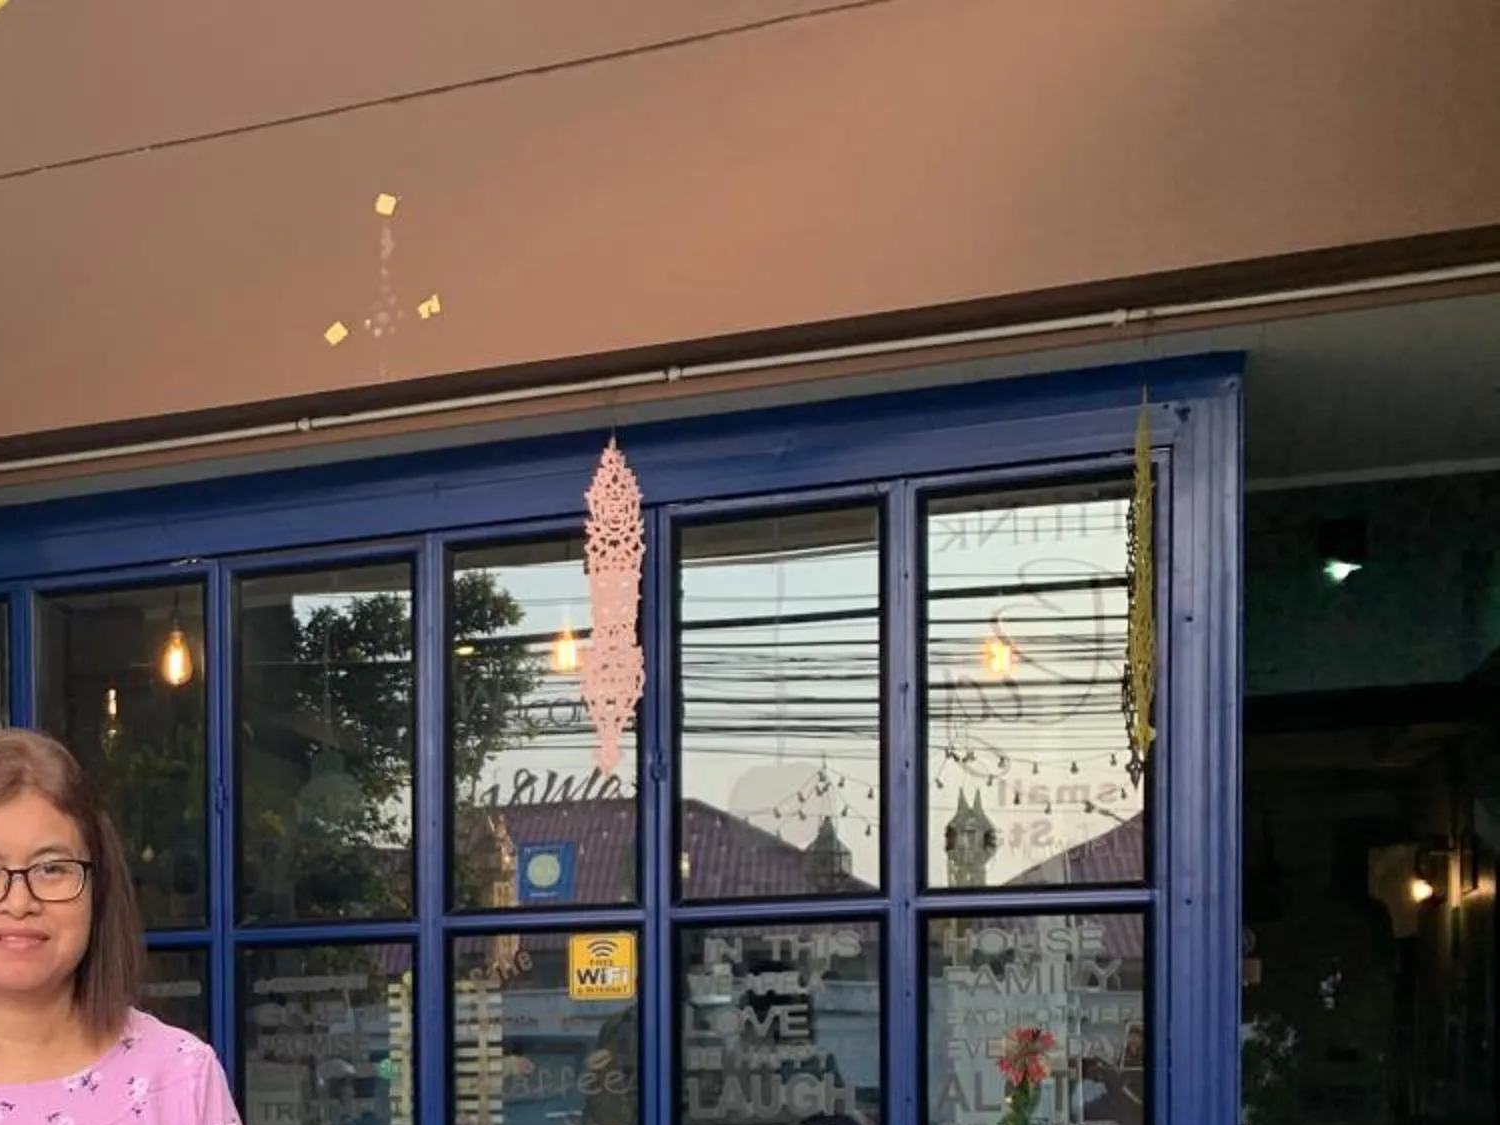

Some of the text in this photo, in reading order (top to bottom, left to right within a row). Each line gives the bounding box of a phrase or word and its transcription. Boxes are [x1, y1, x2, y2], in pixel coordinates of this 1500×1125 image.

[703, 927, 1107, 963] IN THIS HOUSE
[942, 958, 1124, 998] FAMILY
[685, 1002, 811, 1038] LOVE
[686, 1070, 1070, 1119] LAUGH ALT
